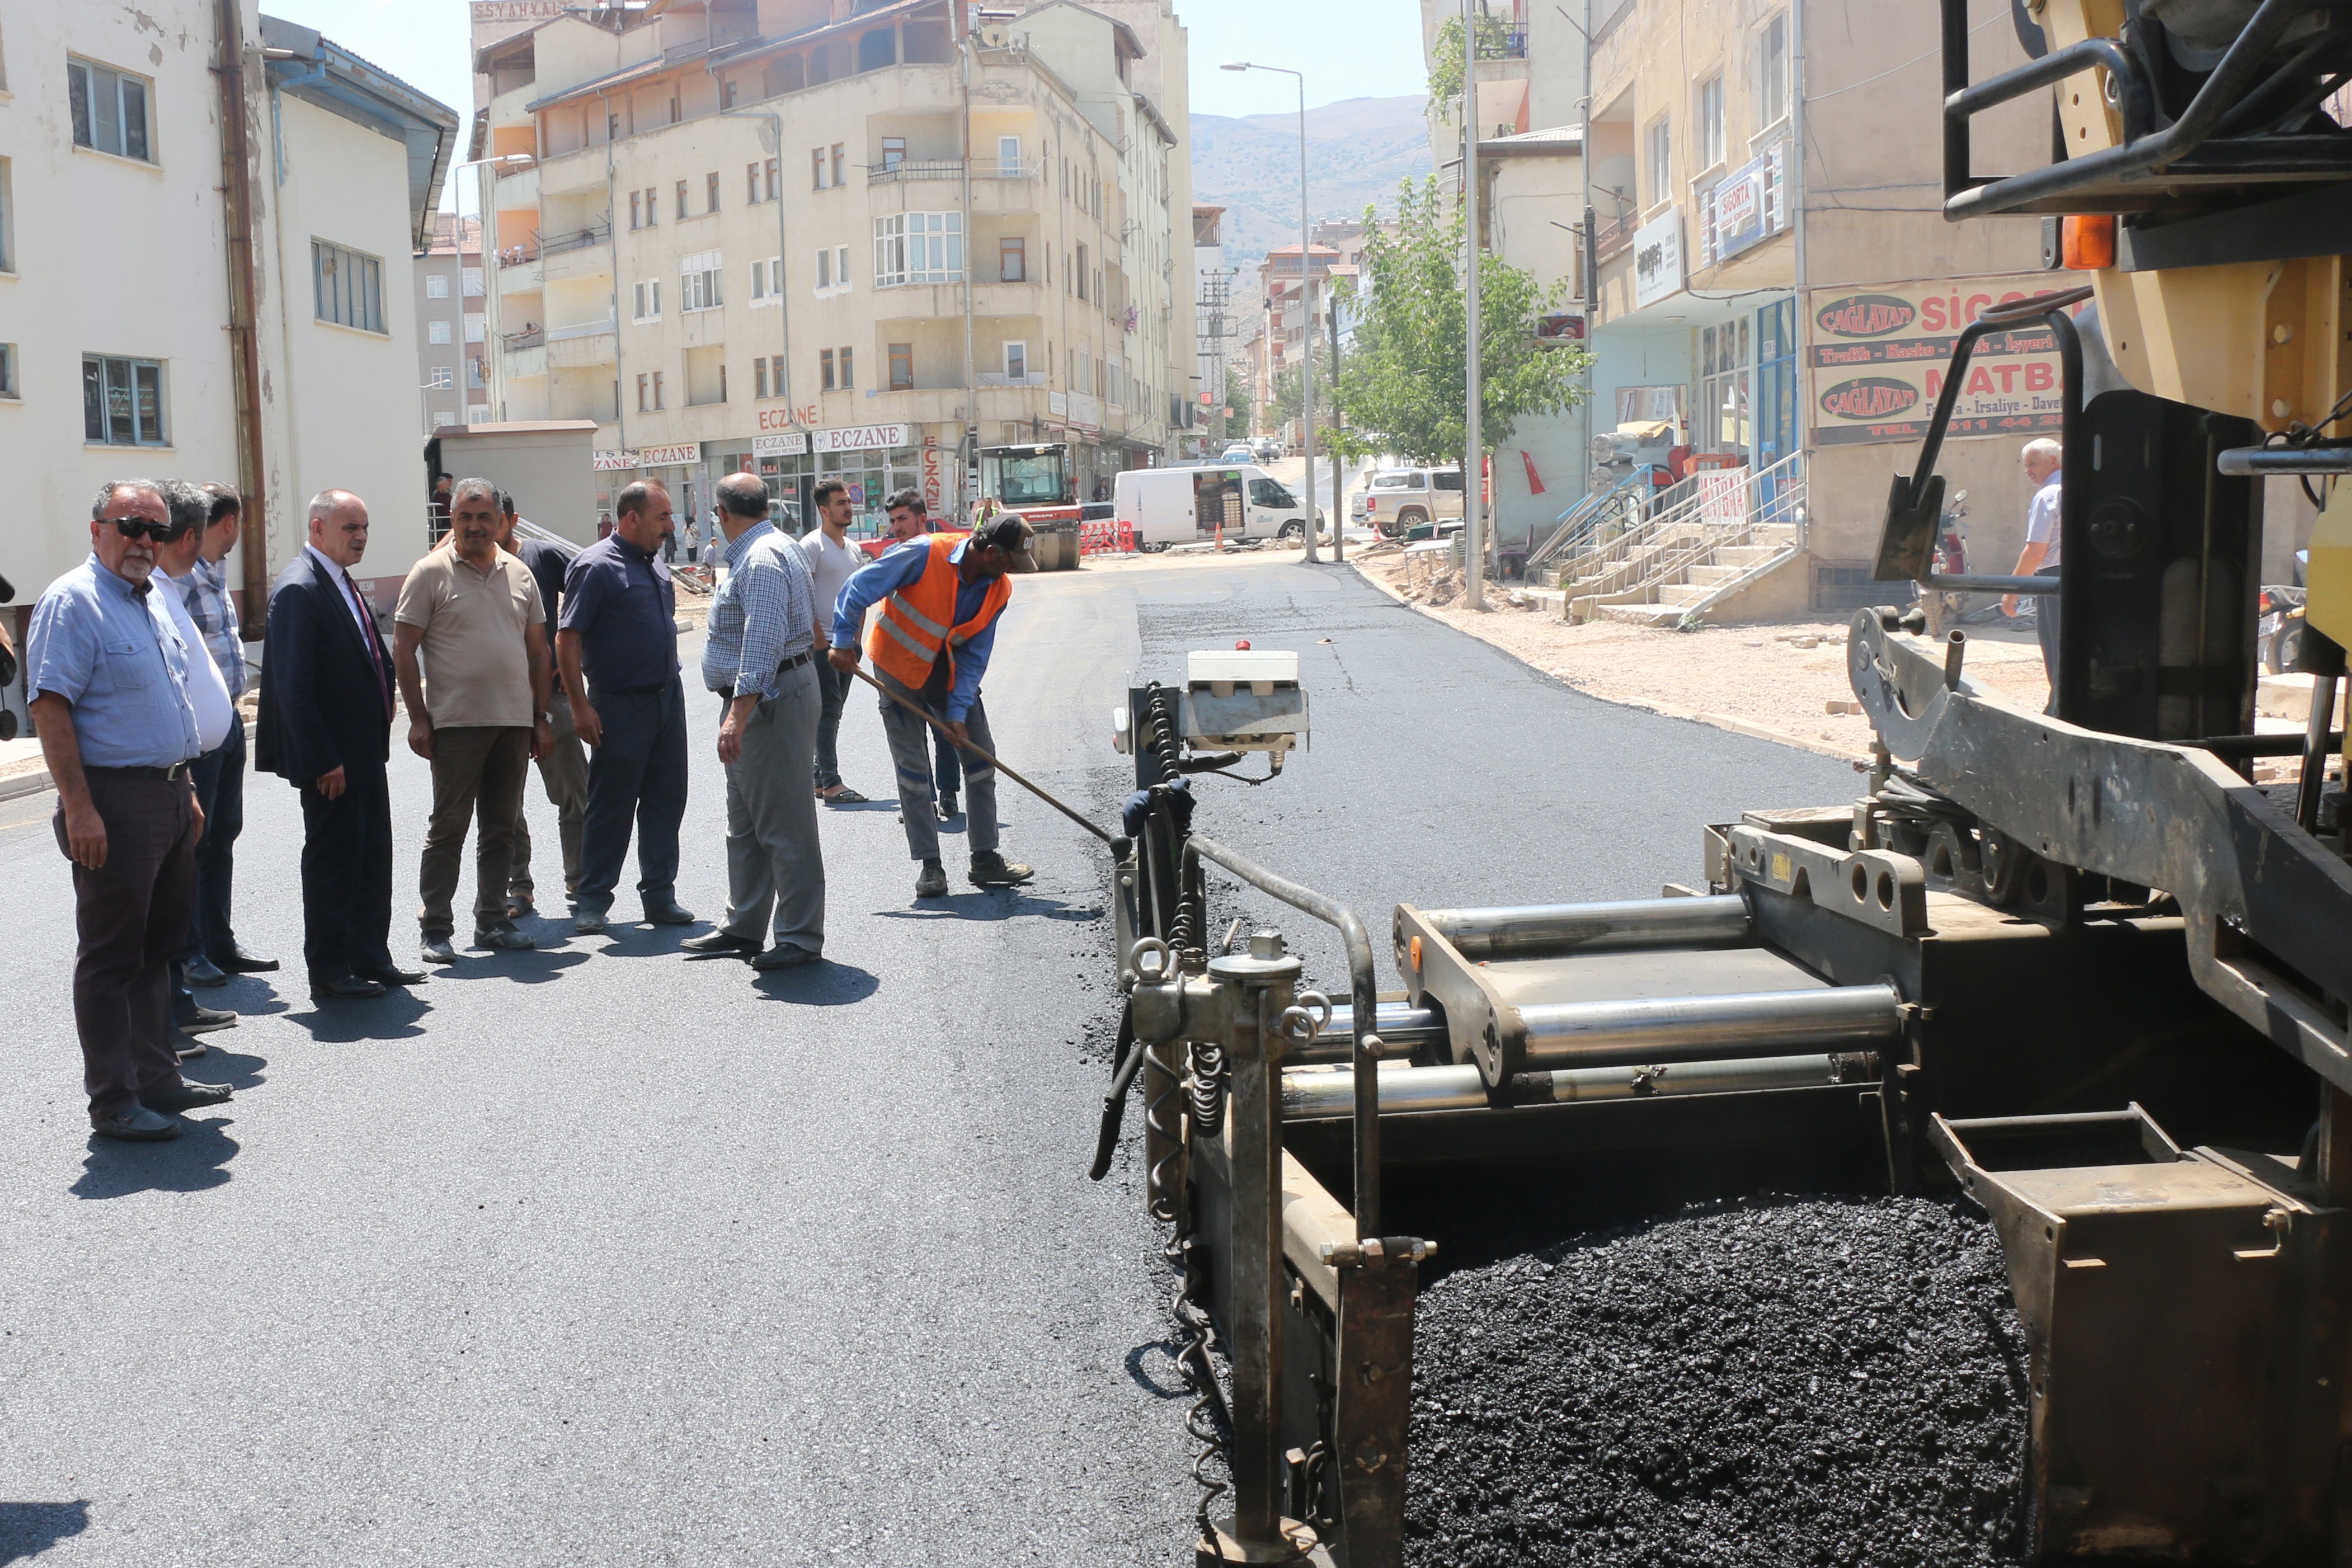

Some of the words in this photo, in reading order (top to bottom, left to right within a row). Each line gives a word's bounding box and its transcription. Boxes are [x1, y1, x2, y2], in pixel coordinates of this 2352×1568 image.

[1723, 182, 1750, 216] SİGORTA
[1821, 297, 1912, 334] ÇAĞLAYAN
[1820, 346, 1871, 363] Trafik
[1885, 342, 1935, 359] Kasko
[2005, 333, 2053, 353] İşyeri
[1925, 362, 2064, 398] MATB
[1824, 379, 1916, 416] ÇAĞLAYAN
[1974, 396, 2020, 415] İrsaliye
[830, 427, 900, 448] ECZANE
[1867, 423, 1918, 436] TEL
[1998, 416, 2032, 428] 44
[644, 446, 695, 464] ECZANE
[755, 436, 803, 449] ECZANE
[924, 436, 940, 510] ECZANE
